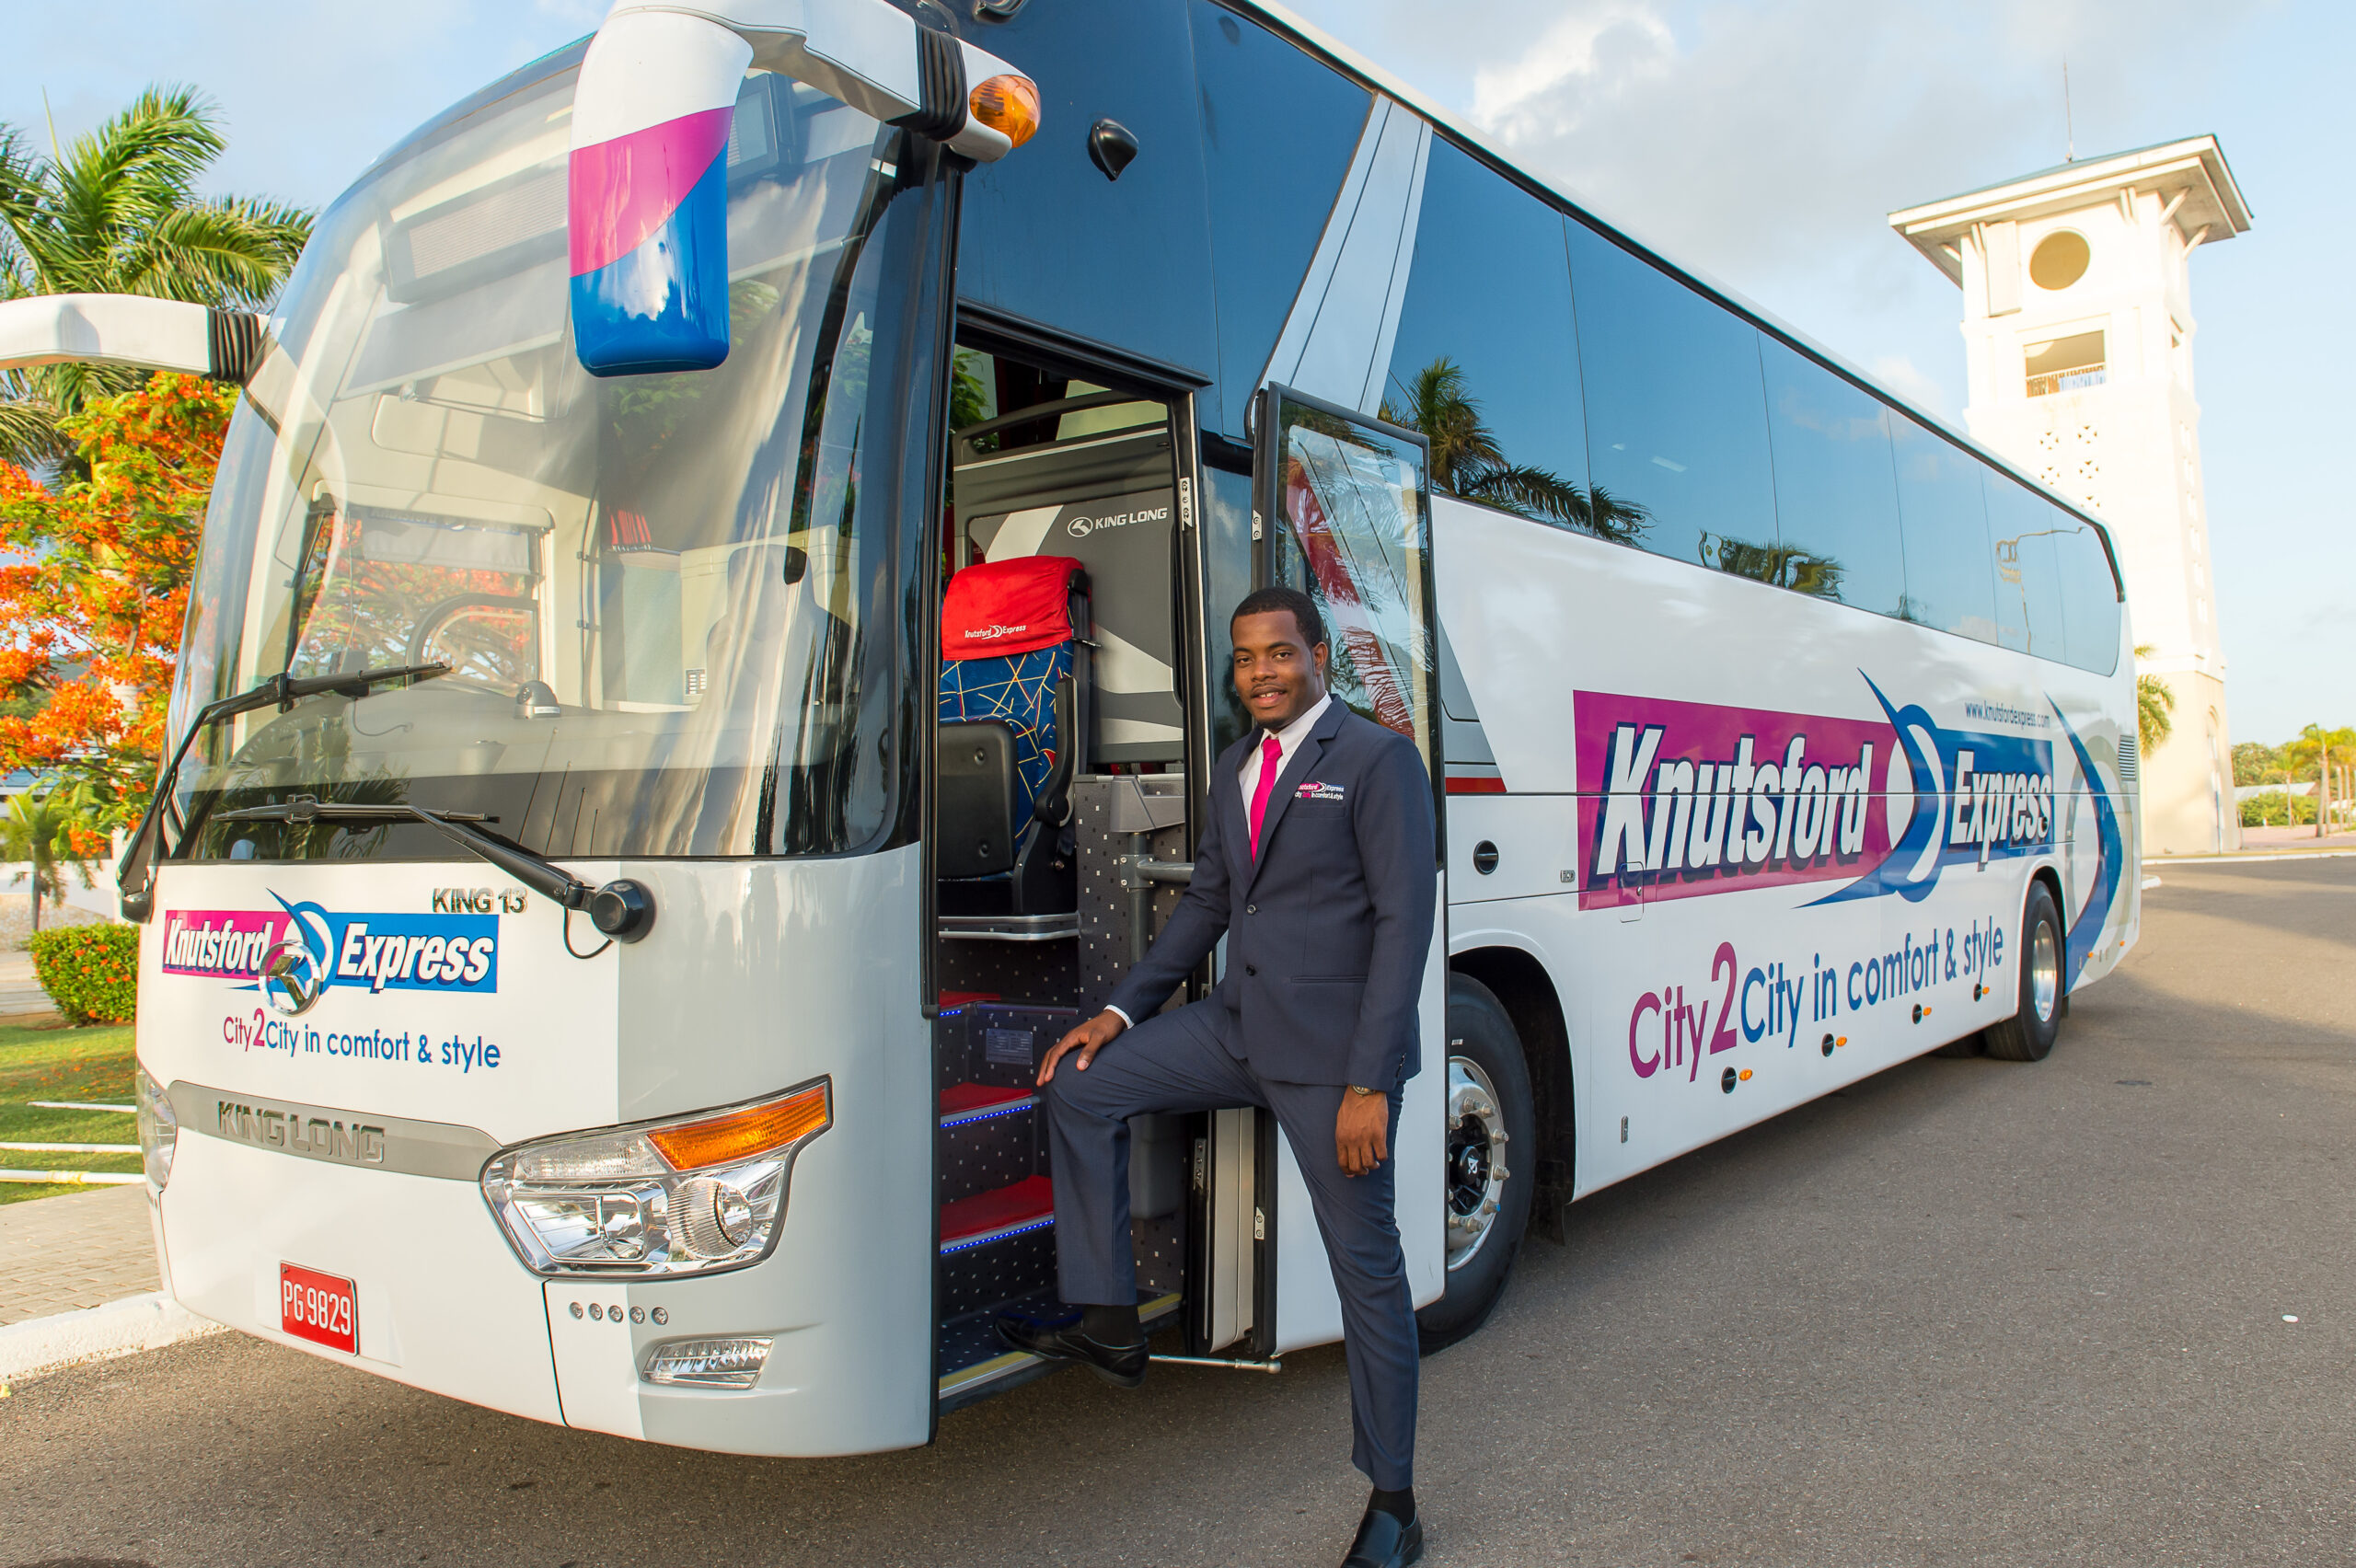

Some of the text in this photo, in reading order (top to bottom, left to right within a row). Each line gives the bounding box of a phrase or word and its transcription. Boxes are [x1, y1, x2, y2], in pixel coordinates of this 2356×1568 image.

[1095, 507, 1168, 530] KING LONG
[964, 625, 1027, 639] Knutsford Express
[1964, 699, 2050, 730] www.knutsfordexpress.com
[1594, 721, 2053, 877] Knutsford Express
[433, 886, 528, 914] KING 13
[164, 918, 495, 990] Knutsford Express
[1629, 916, 2004, 1082] City2City in comfort & style
[223, 1008, 502, 1073] City2City in comfort & style
[217, 1101, 387, 1164] KING LONG
[283, 1280, 352, 1336] PG 9829
